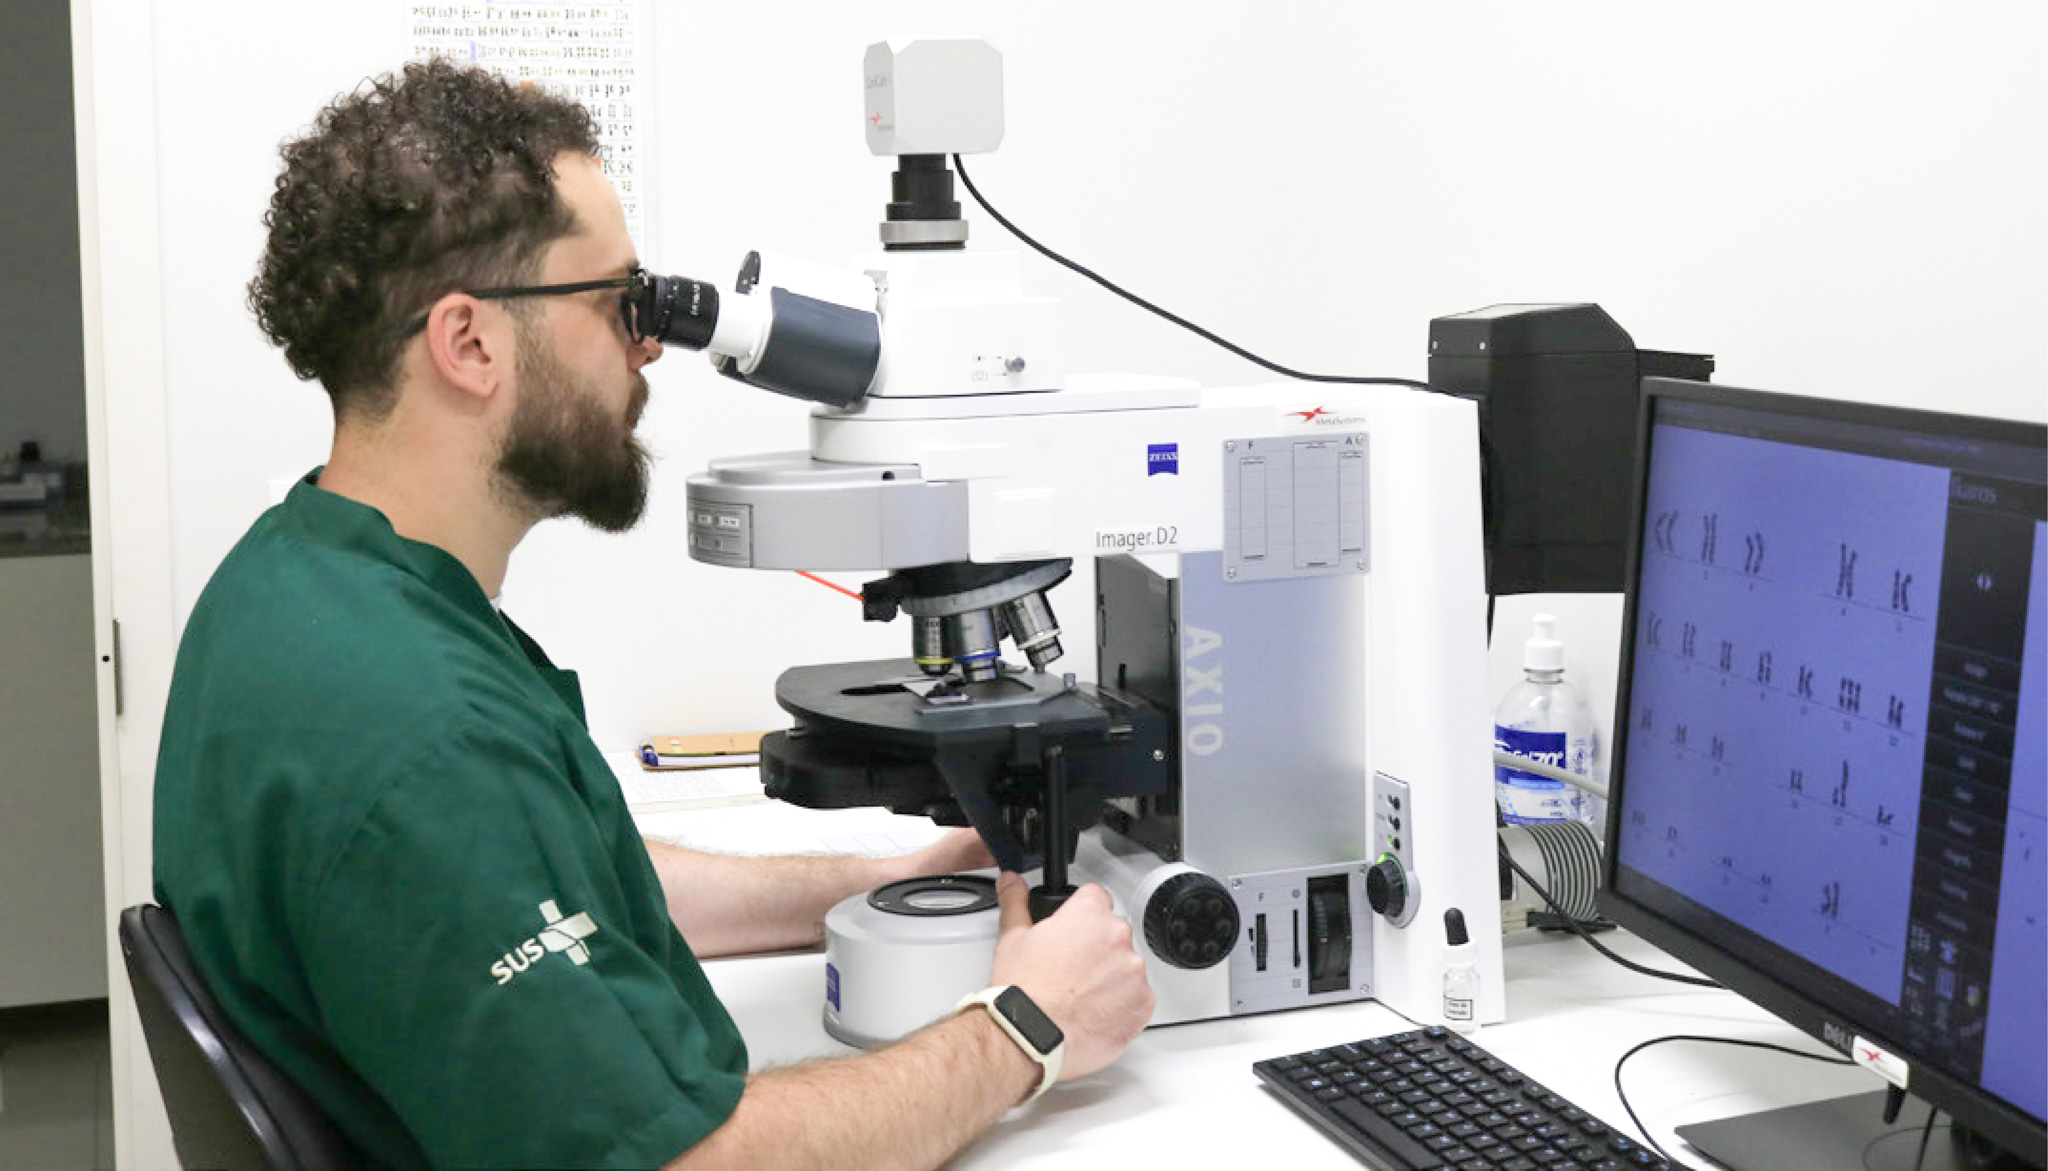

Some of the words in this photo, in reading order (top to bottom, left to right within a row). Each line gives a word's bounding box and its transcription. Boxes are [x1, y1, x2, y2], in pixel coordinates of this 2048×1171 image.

[1248, 440, 1254, 450] F
[1345, 436, 1353, 446] A
[1149, 451, 1178, 462] ZEISS
[1095, 525, 1178, 552] Imager.D2
[1185, 625, 1223, 756] AXIO
[1258, 892, 1265, 902] F
[490, 937, 545, 985] SUS
